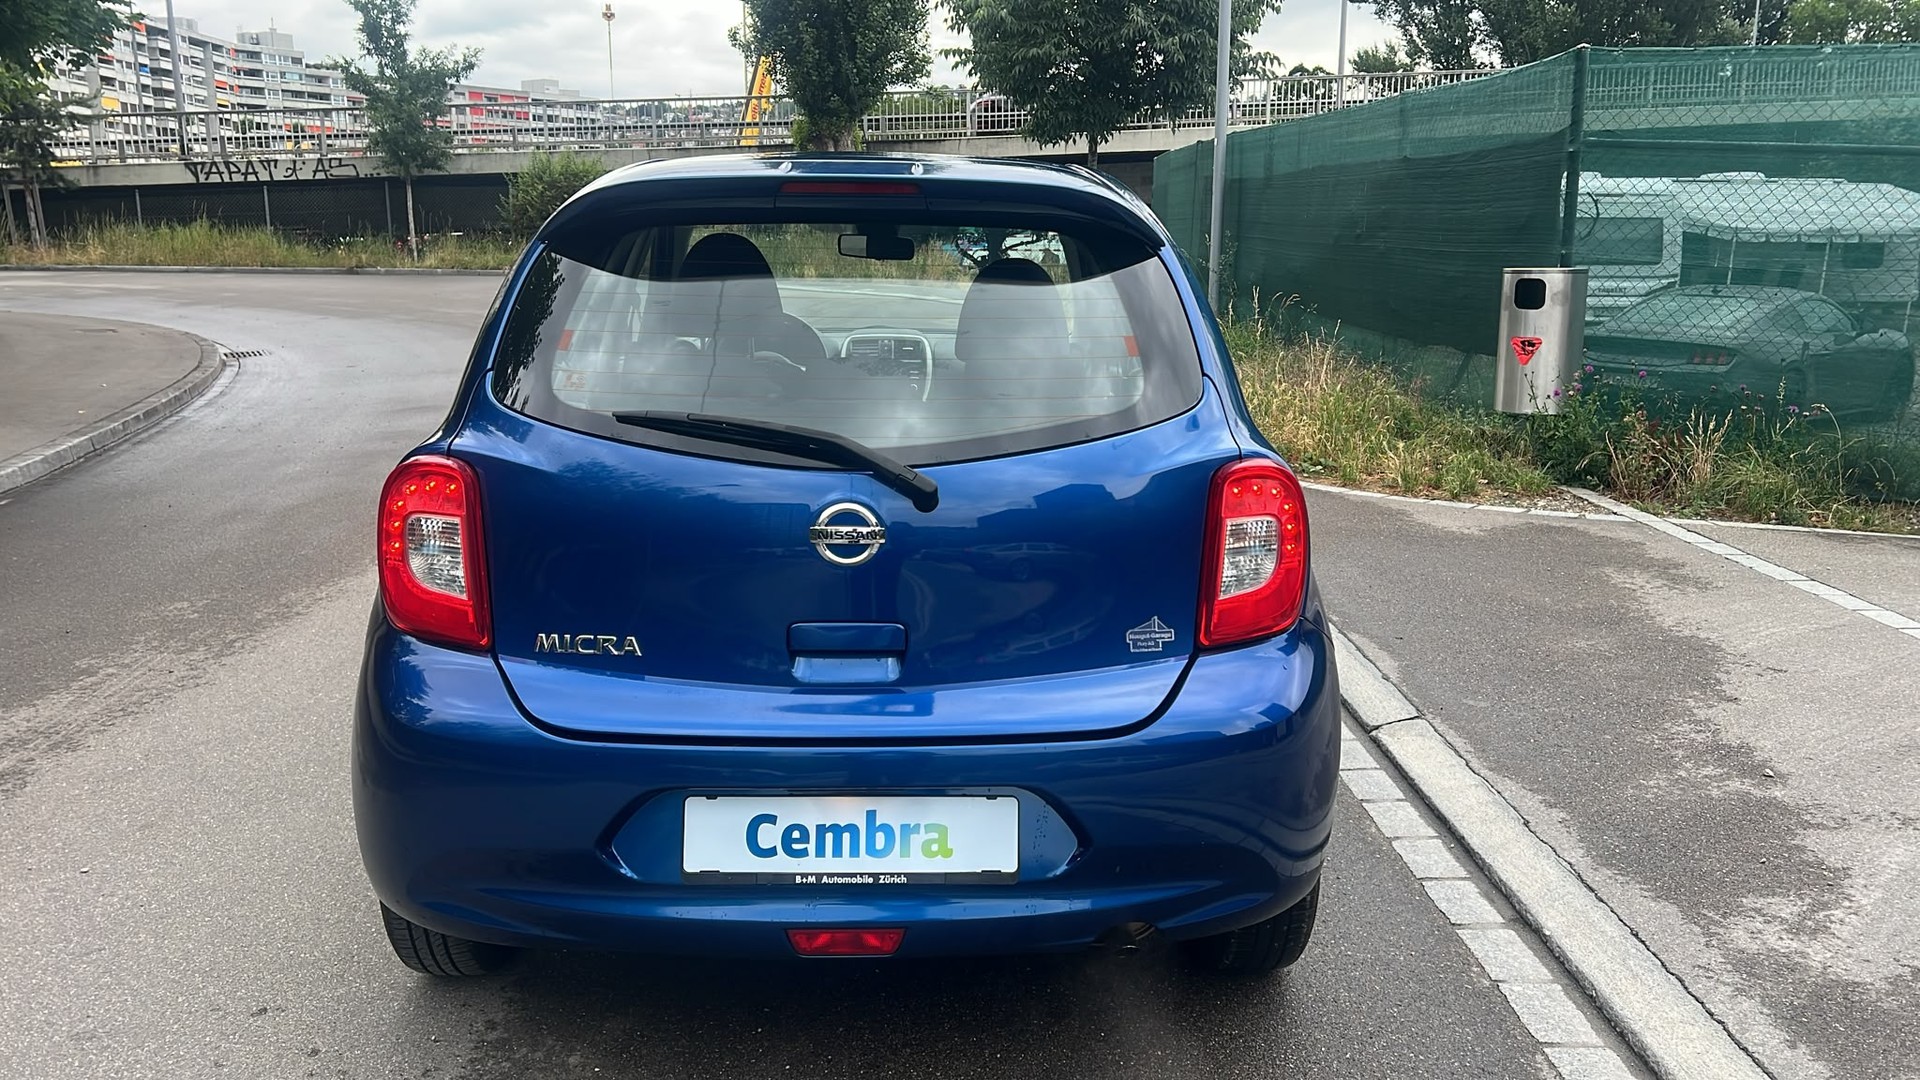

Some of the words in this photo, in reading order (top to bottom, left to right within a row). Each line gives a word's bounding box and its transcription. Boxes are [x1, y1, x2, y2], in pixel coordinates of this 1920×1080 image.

[817, 529, 879, 541] NISSAN
[534, 633, 642, 656] MICRA
[745, 809, 954, 859] Cembra
[795, 874, 817, 884] B+M
[821, 874, 874, 884] Automobile
[878, 873, 908, 884] Zürich
